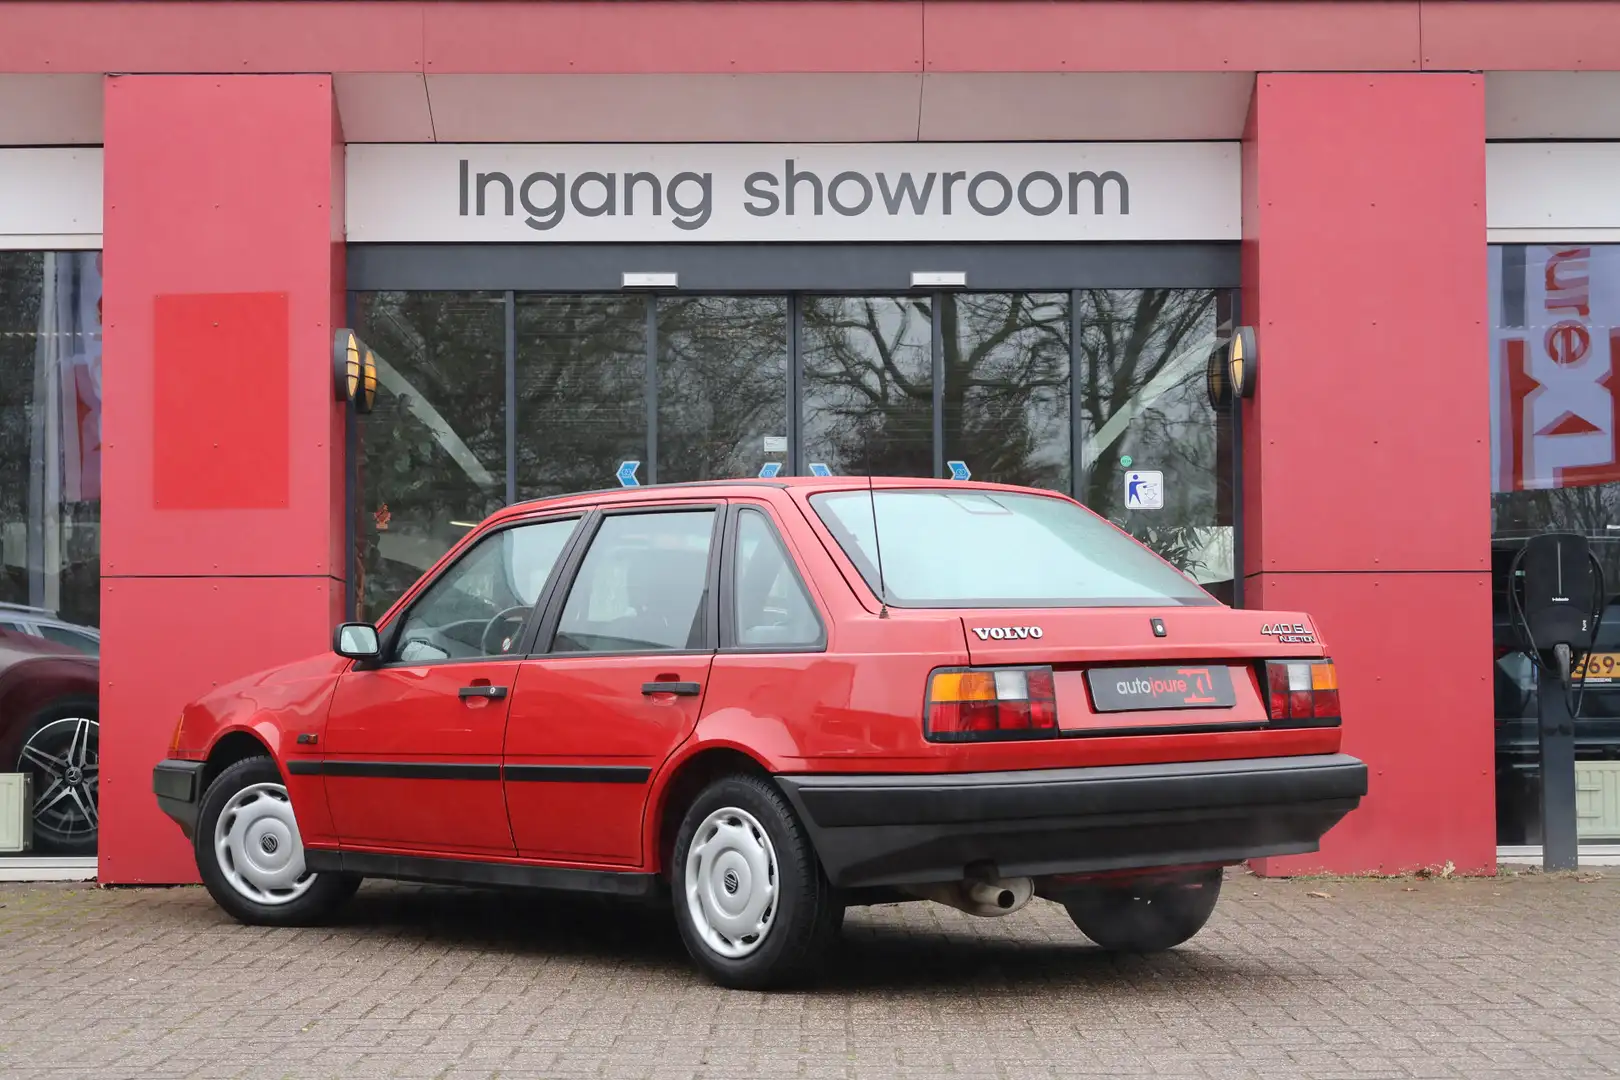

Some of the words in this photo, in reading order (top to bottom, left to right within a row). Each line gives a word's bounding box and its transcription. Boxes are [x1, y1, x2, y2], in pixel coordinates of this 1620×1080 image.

[459, 159, 713, 231] Ingang
[743, 158, 1131, 217] showroom
[972, 626, 1044, 641] VOLVO
[1116, 676, 1188, 698] autojoure
